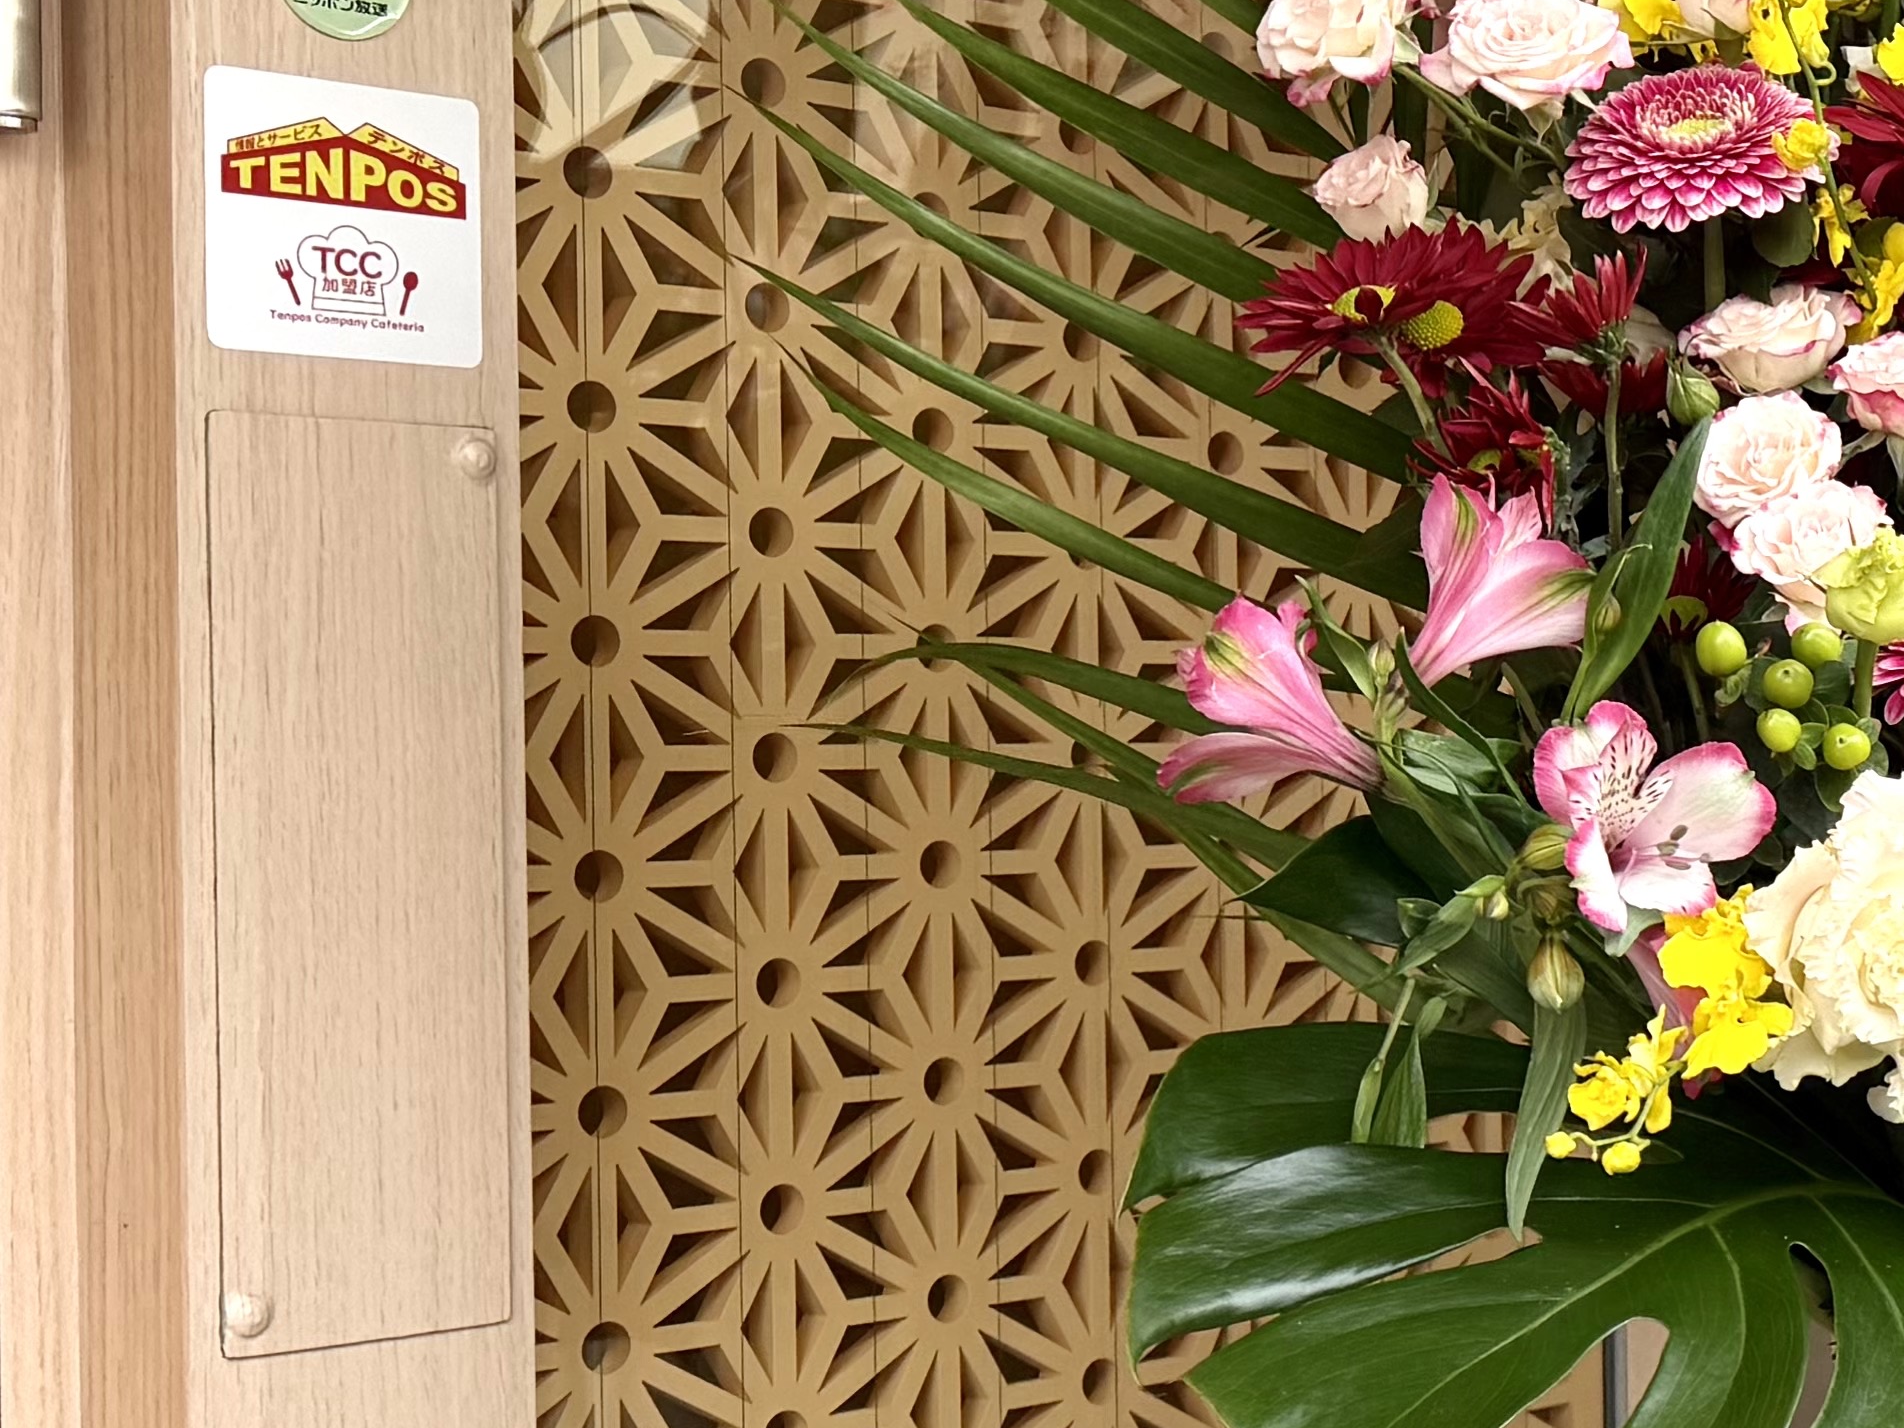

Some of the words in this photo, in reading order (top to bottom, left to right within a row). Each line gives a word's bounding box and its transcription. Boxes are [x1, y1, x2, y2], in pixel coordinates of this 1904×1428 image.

[229, 147, 458, 213] TENPOS
[311, 245, 383, 280] TCC
[321, 277, 378, 298] 加盟店
[270, 309, 312, 323] Tenpos
[315, 313, 368, 330] Company
